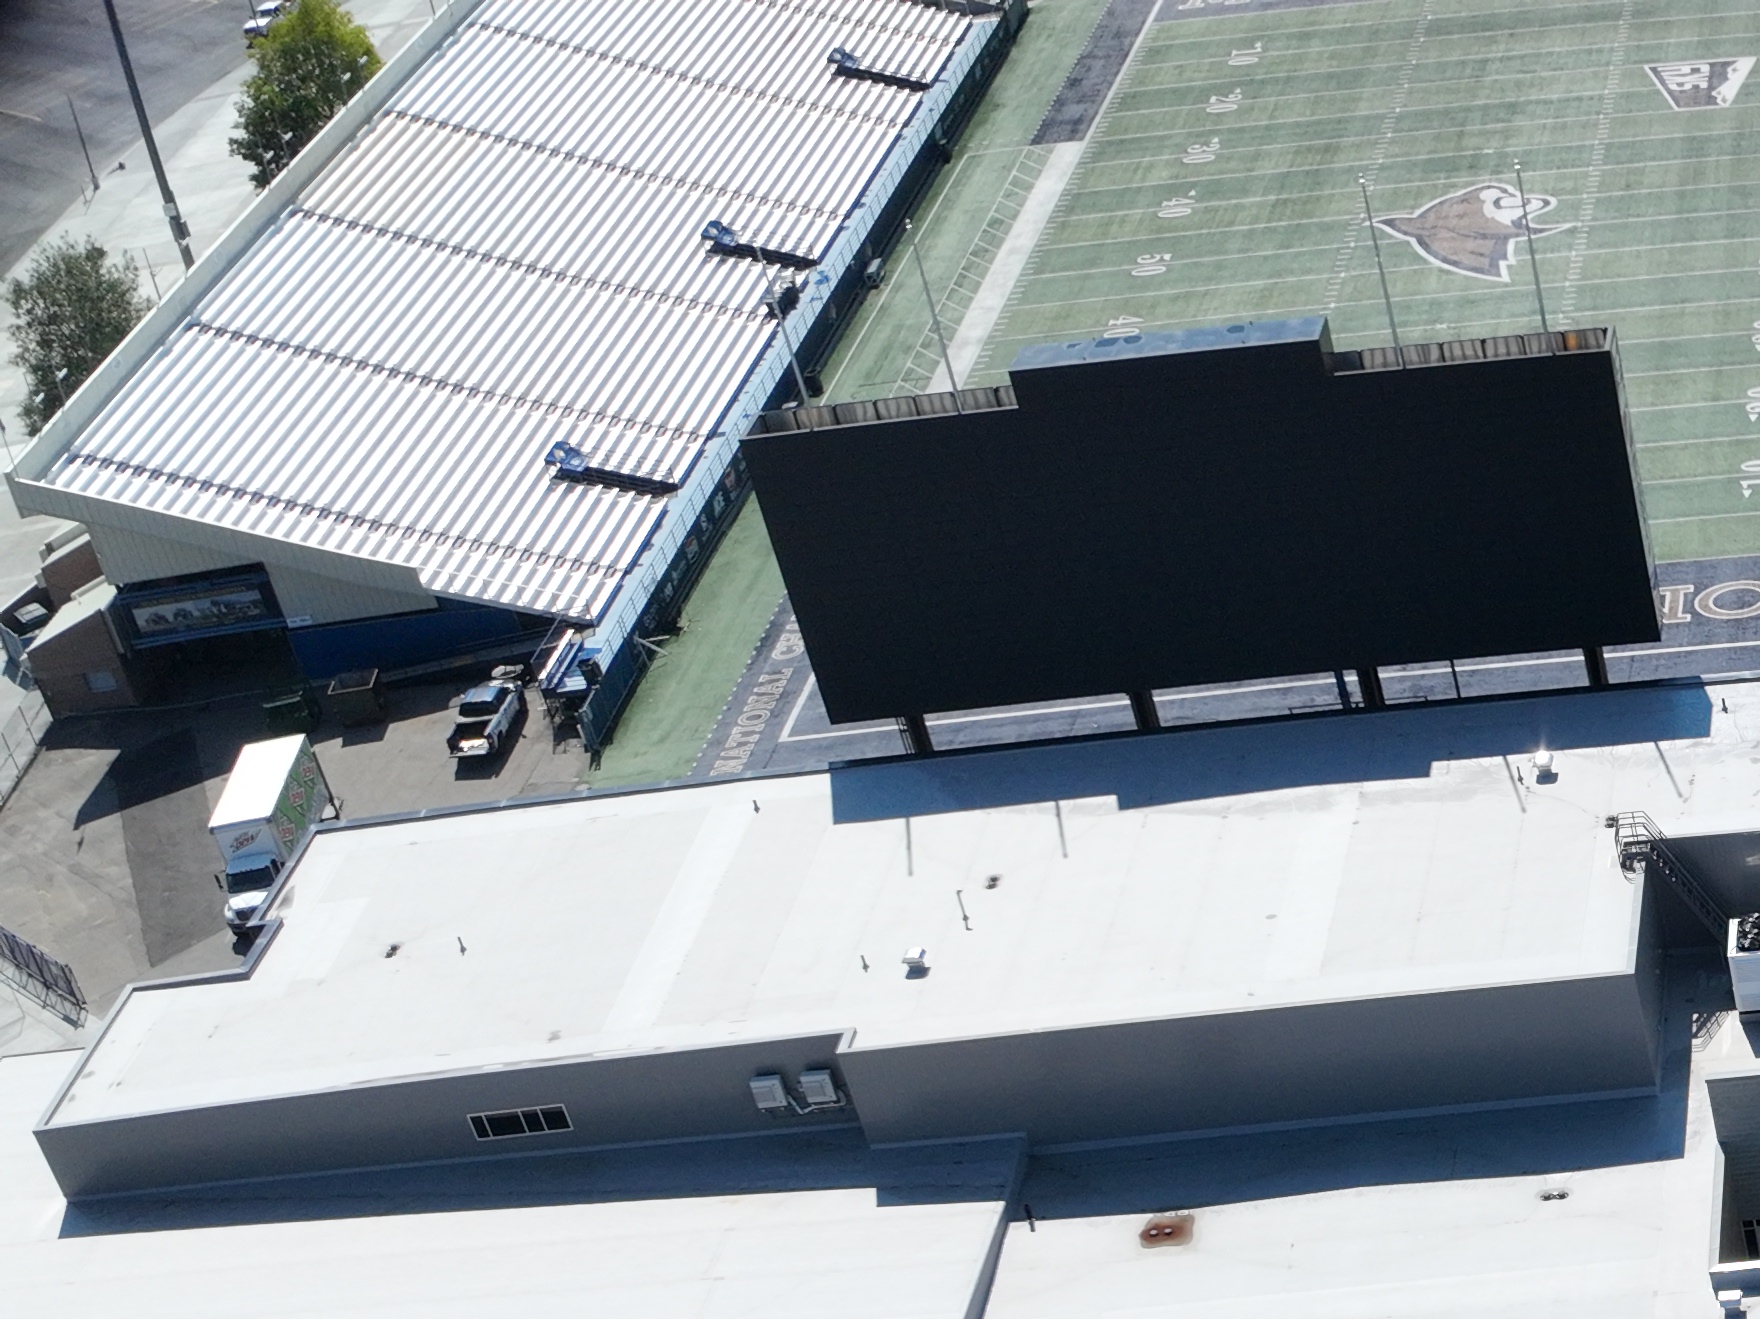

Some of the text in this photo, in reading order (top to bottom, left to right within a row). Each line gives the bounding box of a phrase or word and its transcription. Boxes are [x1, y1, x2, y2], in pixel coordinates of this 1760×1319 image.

[1228, 47, 1262, 65] 10
[1657, 63, 1711, 91] SKY
[1206, 94, 1243, 113] 20
[1182, 143, 1220, 164] 30
[1157, 197, 1196, 218] 40
[1131, 254, 1173, 276] 50
[1103, 315, 1144, 338] 40
[709, 614, 805, 777] NATIONAL CH
